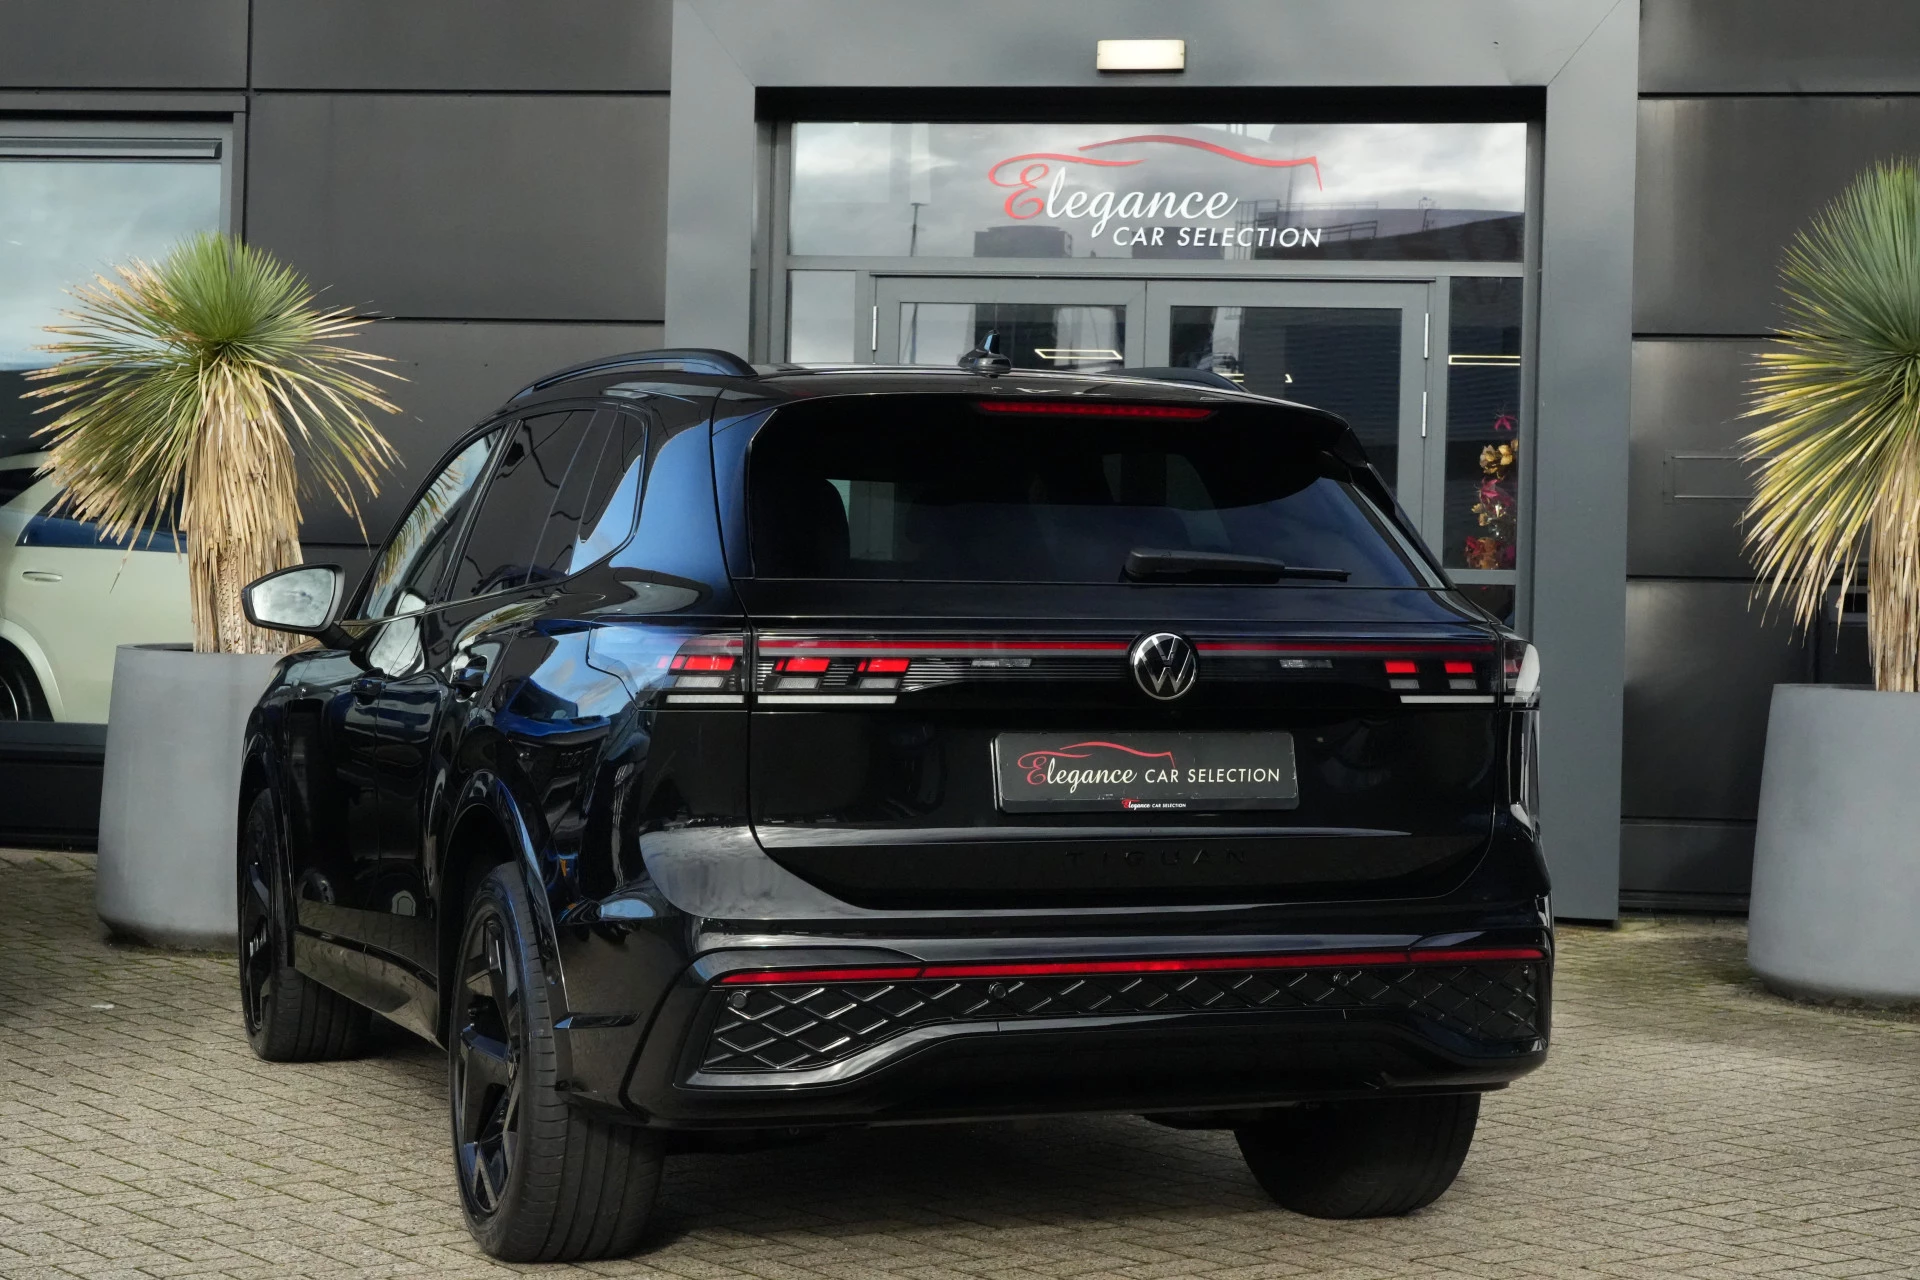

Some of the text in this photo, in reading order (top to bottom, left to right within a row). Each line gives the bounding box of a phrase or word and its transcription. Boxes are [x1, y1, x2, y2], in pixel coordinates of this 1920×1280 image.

[988, 152, 1239, 239] Elegance
[1113, 226, 1322, 248] CAR SELECTION
[1017, 751, 1280, 794] Elegance CAR SELECTION
[1121, 799, 1151, 811] Elegance
[1065, 849, 1246, 866] TIGUAN
